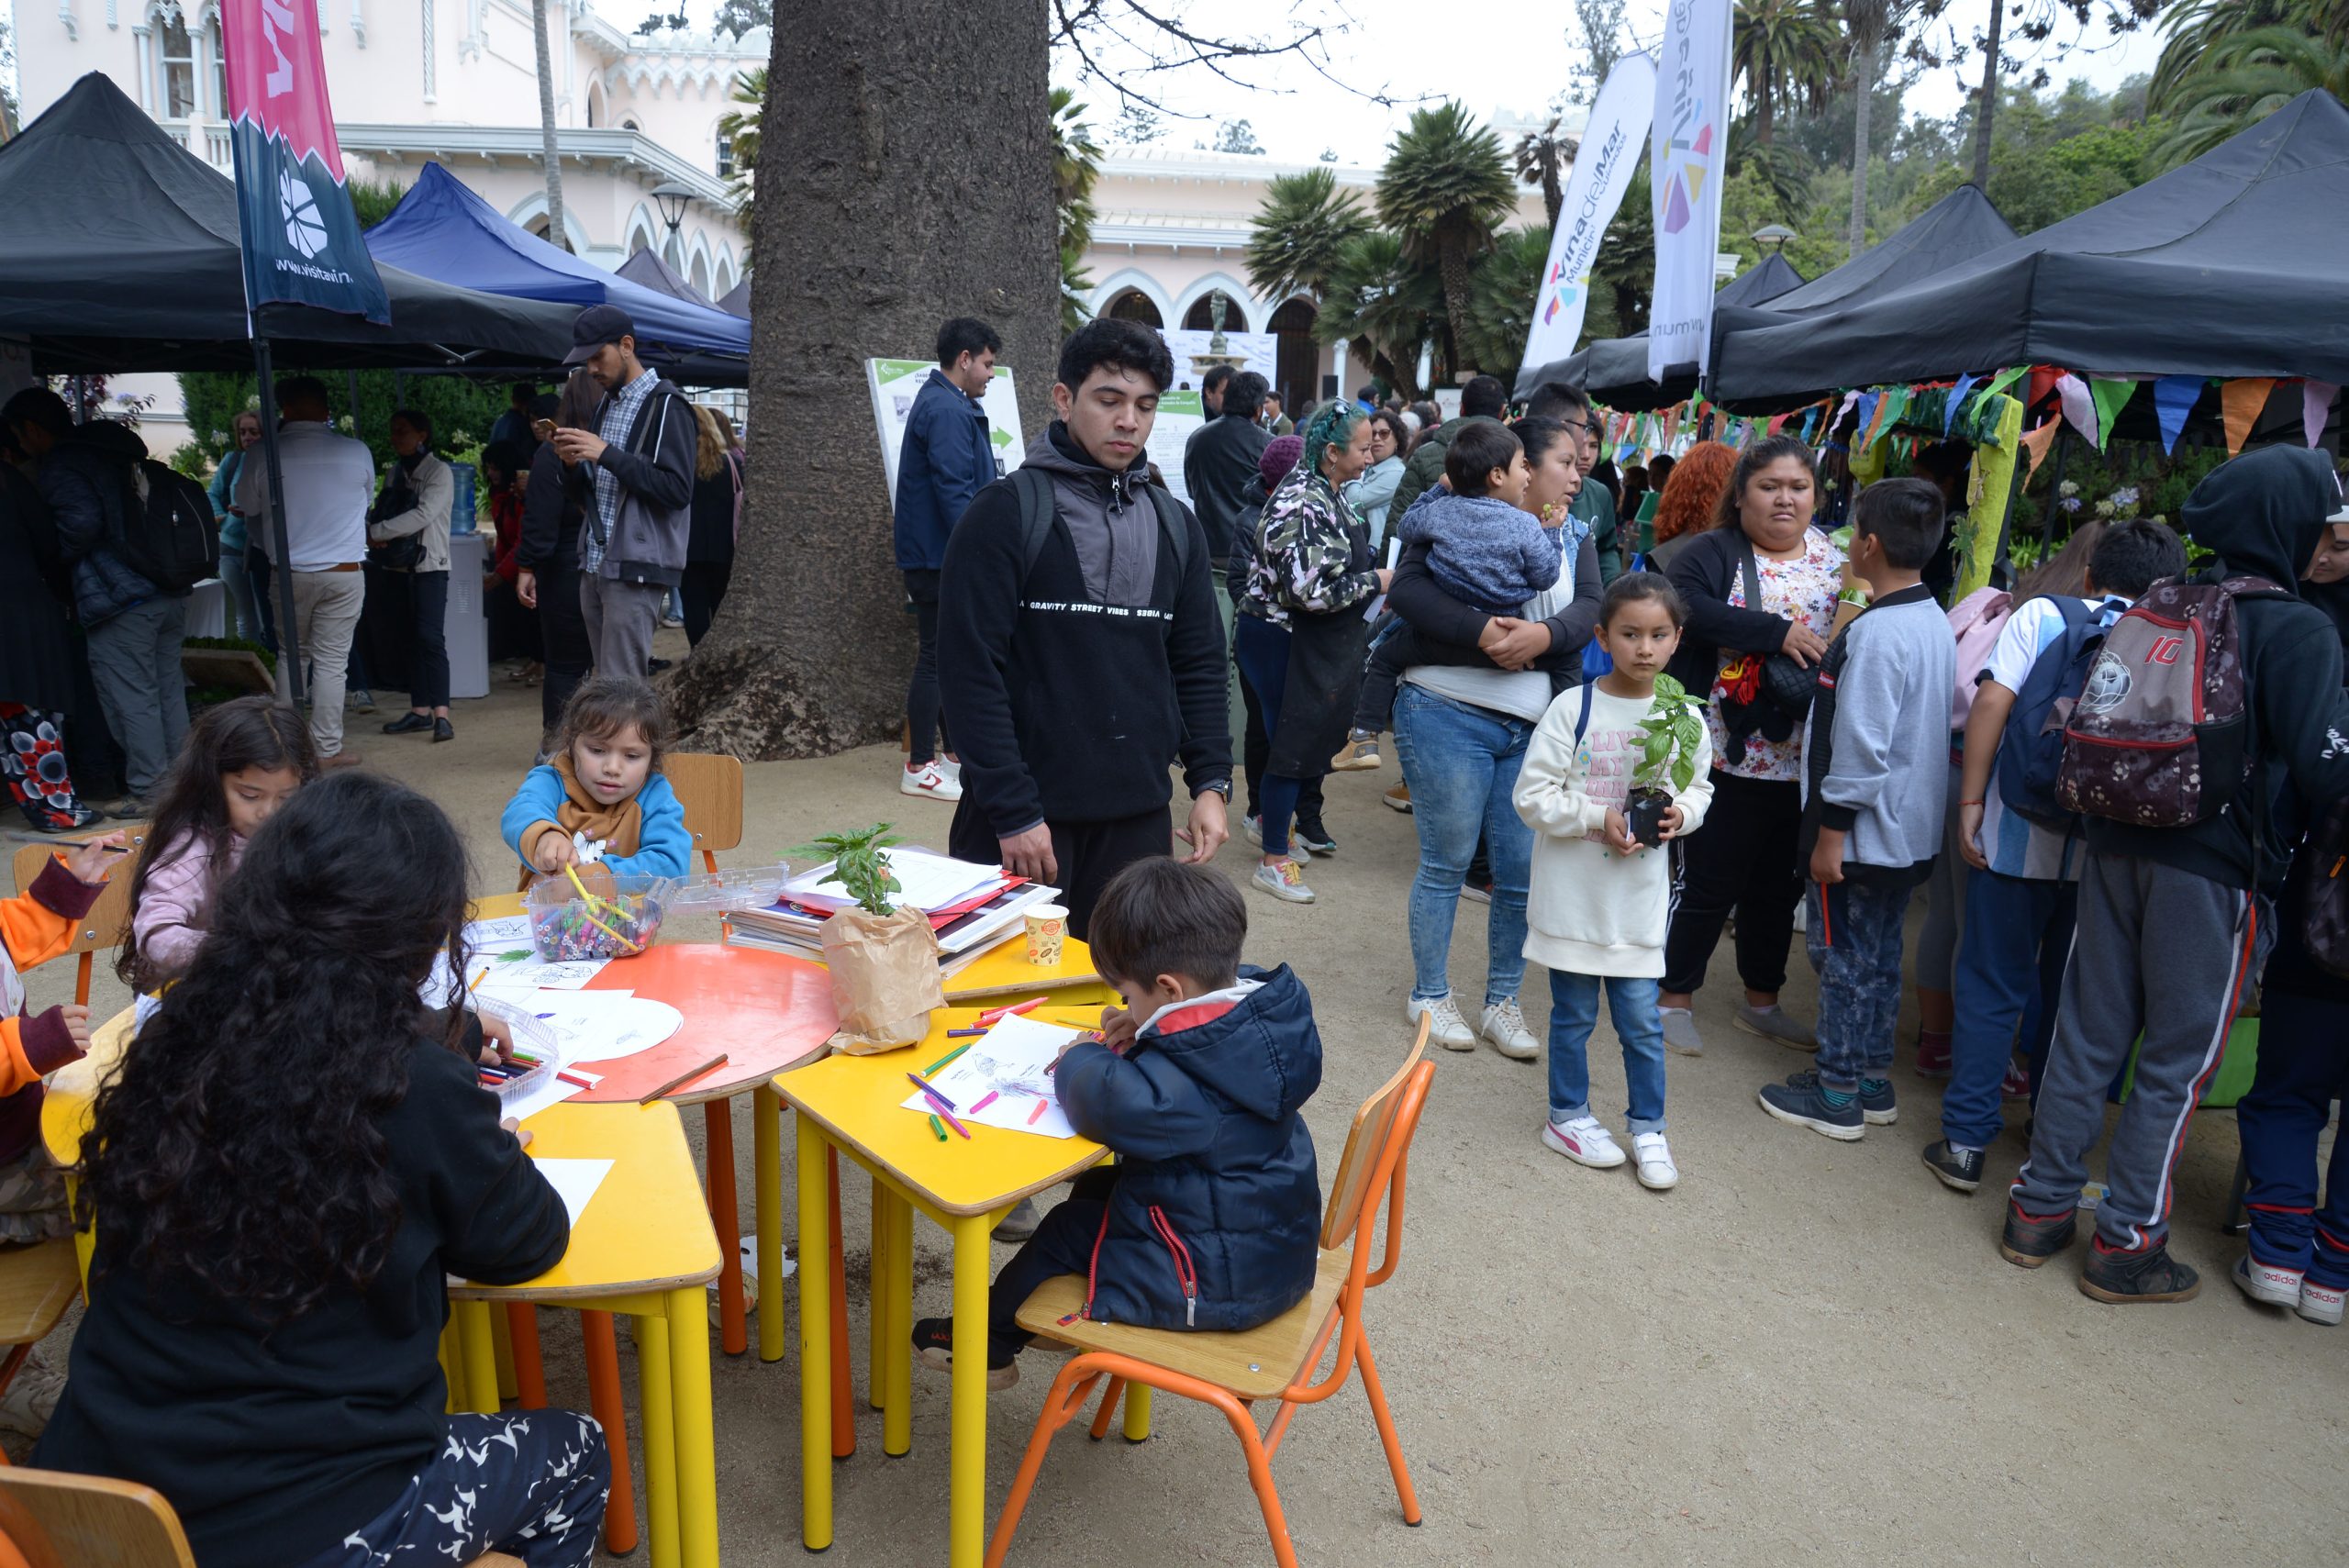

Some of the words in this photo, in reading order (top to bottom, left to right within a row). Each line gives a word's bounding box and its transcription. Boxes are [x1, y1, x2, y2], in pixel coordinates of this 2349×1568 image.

[1030, 601, 1066, 612] GRAVITY
[1071, 603, 1103, 614] STREET
[1107, 606, 1130, 617] VIBES
[2143, 635, 2185, 666] 10
[1589, 755, 1623, 777] MY
[2264, 1272, 2298, 1285] adidas
[2304, 1287, 2341, 1304] adidas
